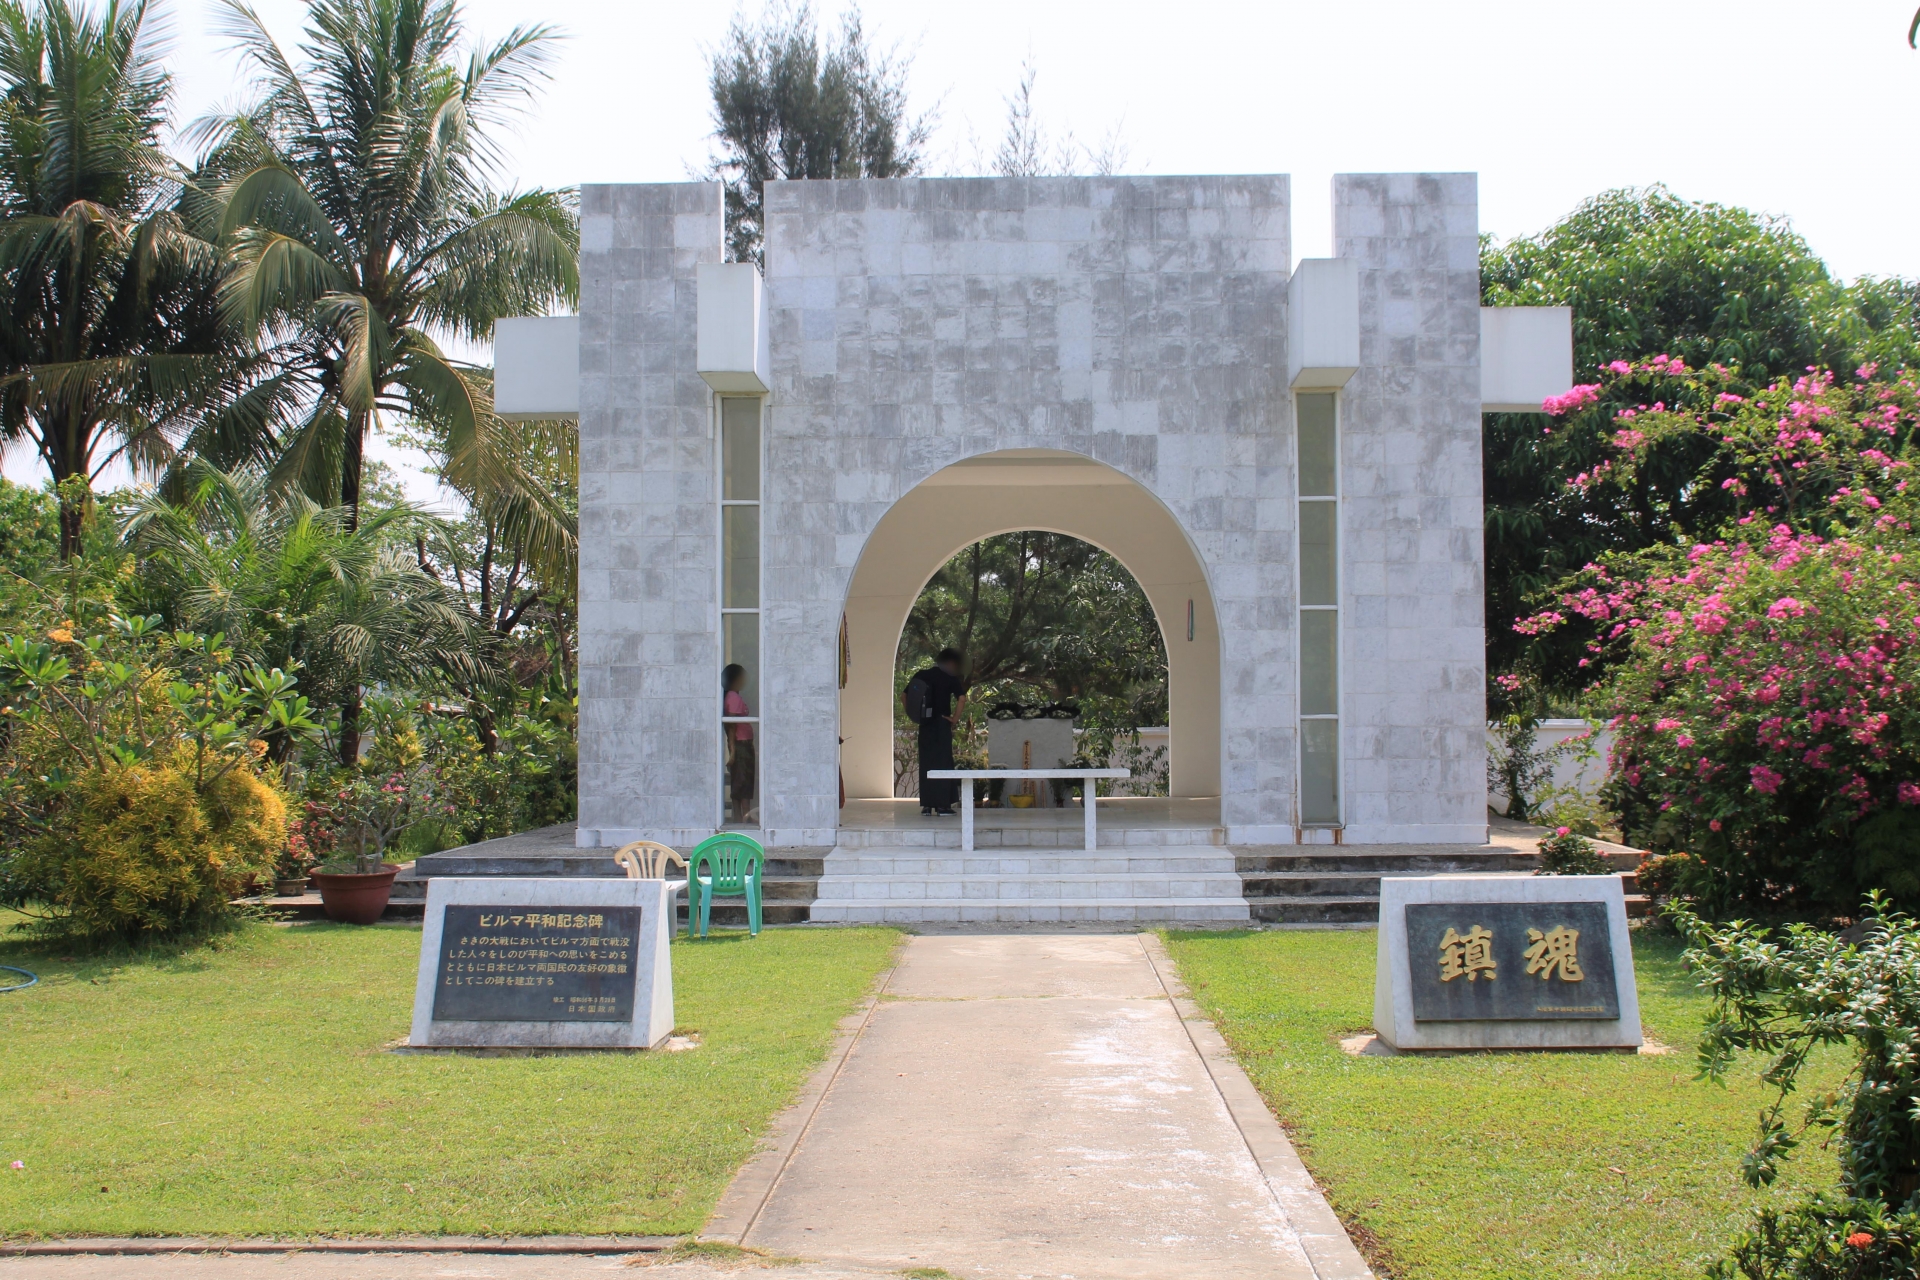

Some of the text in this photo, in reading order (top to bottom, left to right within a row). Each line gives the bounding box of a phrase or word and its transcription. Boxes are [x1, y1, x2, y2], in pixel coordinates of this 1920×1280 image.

[479, 914, 604, 928] ビルマ平和記念碑
[460, 936, 629, 947] さきの大戦においてビルマ方面で戦没
[449, 949, 627, 960] した人々をしのび平和への思いをこめる
[1439, 925, 1584, 982] 鎮魂
[446, 962, 627, 974] とともに日本ビルマ両国民の友好の象徴
[445, 976, 554, 986] としてこの碑を建立する
[568, 1005, 615, 1013] 日本国政府
